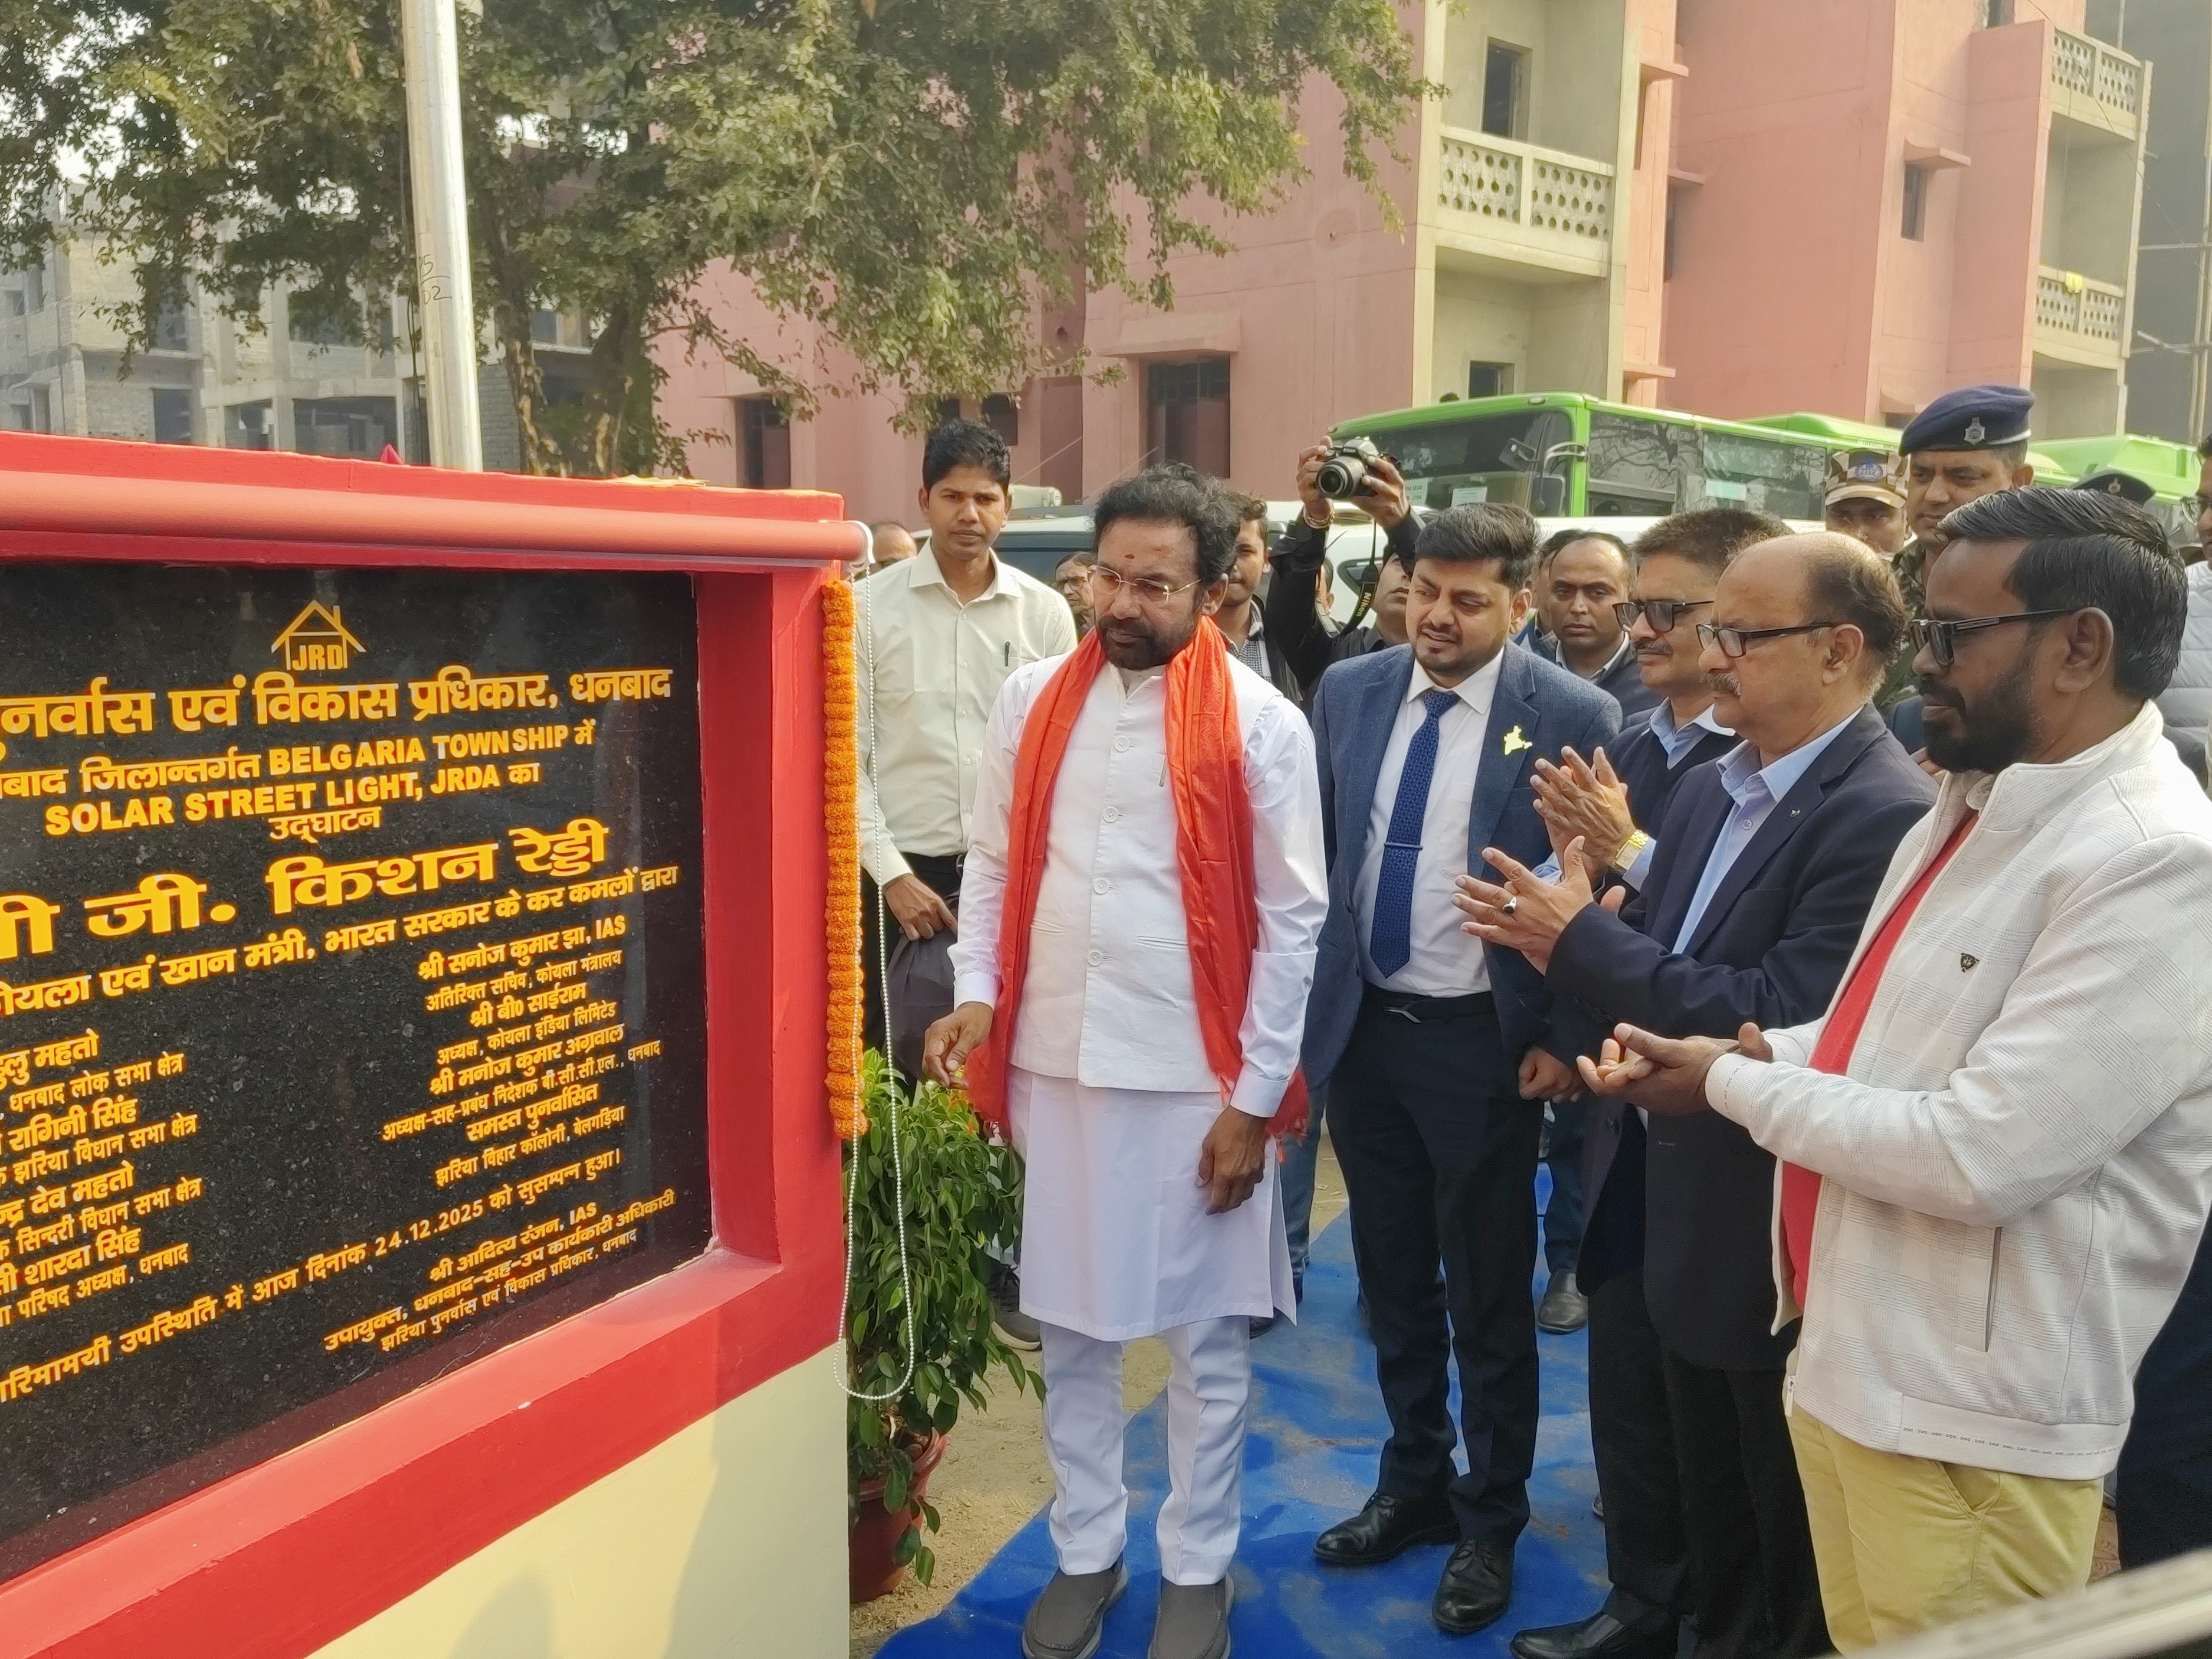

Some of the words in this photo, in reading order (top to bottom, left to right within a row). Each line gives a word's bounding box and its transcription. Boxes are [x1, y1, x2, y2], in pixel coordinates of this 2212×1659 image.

[1356, 592, 1372, 617] Nikon
[0, 676, 156, 762] नर्वास
[168, 674, 246, 732] एवं
[252, 671, 399, 724] विकास
[570, 669, 673, 703] धनबाद
[80, 746, 261, 792] जिलान्तर्गत
[269, 737, 426, 775] BELGARIA
[574, 719, 596, 745] में
[45, 796, 175, 836] SOLAR
[185, 783, 317, 822] STREET
[326, 772, 423, 801] LIGHT,
[431, 764, 500, 794] JRDA
[508, 763, 540, 784] का
[84, 873, 235, 936] जी.
[265, 843, 499, 914] किशन
[508, 818, 609, 877] रेड्डी
[99, 954, 156, 997] एवं
[159, 948, 237, 985] खान
[243, 928, 315, 968] मंत्री,
[325, 919, 397, 952] भारत
[403, 901, 491, 937] सरकार
[494, 889, 521, 917] के
[526, 887, 565, 912] कर
[568, 866, 639, 902] कमलों
[640, 866, 678, 892] द्वारा
[418, 951, 445, 980] श्री
[448, 942, 505, 974] सनोज
[510, 932, 559, 966] कुमार
[562, 926, 591, 949] झा,
[595, 915, 626, 940] IAS
[425, 981, 487, 1011] अतिरिक्त
[535, 960, 577, 984] कोयला
[580, 949, 622, 973] मंत्रालय
[469, 1000, 494, 1028] श्री
[526, 982, 587, 1012] साईराम
[33, 1028, 99, 1068] महतो
[487, 1028, 531, 1051] कोयला
[534, 1014, 570, 1040] इंडिया
[573, 999, 617, 1027] लिमिटेड
[9, 1083, 65, 1112] धनबाद
[69, 1069, 109, 1098] लोक
[114, 1061, 152, 1087] सभा
[157, 1051, 184, 1076] क्षेत्र
[429, 1067, 454, 1095] श्री
[458, 1056, 512, 1087] मनोज
[515, 1041, 563, 1076] कुमार
[565, 1023, 625, 1054] अग्रवाल
[8, 1105, 87, 1151] रागिनी
[91, 1094, 138, 1130] सिंह
[466, 1108, 521, 1141] समस्त
[524, 1083, 598, 1129] पुनर्वासित
[493, 1079, 538, 1107] निदेशक
[13, 1150, 69, 1184] झरिया
[74, 1134, 125, 1166] विधान
[129, 1123, 166, 1149] सभा
[171, 1112, 198, 1138] क्षेत्र
[435, 1157, 479, 1187] झरिया
[482, 1143, 516, 1169] विहार
[30, 1185, 67, 1215] देव
[72, 1159, 134, 1202] महतो
[79, 1201, 130, 1233] विधान
[133, 1188, 171, 1215] सभा
[175, 1177, 202, 1202] क्षेत्र
[430, 1258, 453, 1282] श्री
[456, 1234, 518, 1271] आदित्य
[520, 1215, 565, 1246] रंजन,
[570, 1202, 597, 1226] IAS
[547, 1217, 613, 1258] कार्यकारी
[616, 1188, 676, 1230] अधिकारी
[17, 1285, 71, 1318] परिषद
[139, 1243, 189, 1274] धनबाद
[24, 1245, 91, 1285] शारदा
[96, 1226, 141, 1262] सिंह
[120, 1298, 219, 1352] उपस्थिति
[225, 1285, 246, 1310] में
[253, 1267, 298, 1301] आज
[307, 1242, 367, 1282] दिनांक
[375, 1200, 484, 1256] 24.12.2025
[489, 1185, 513, 1210] को
[517, 1168, 581, 1205] सुसम्पन्न
[381, 1318, 426, 1352] झरिया
[482, 1284, 501, 1307] एवं
[504, 1266, 547, 1297] विकास
